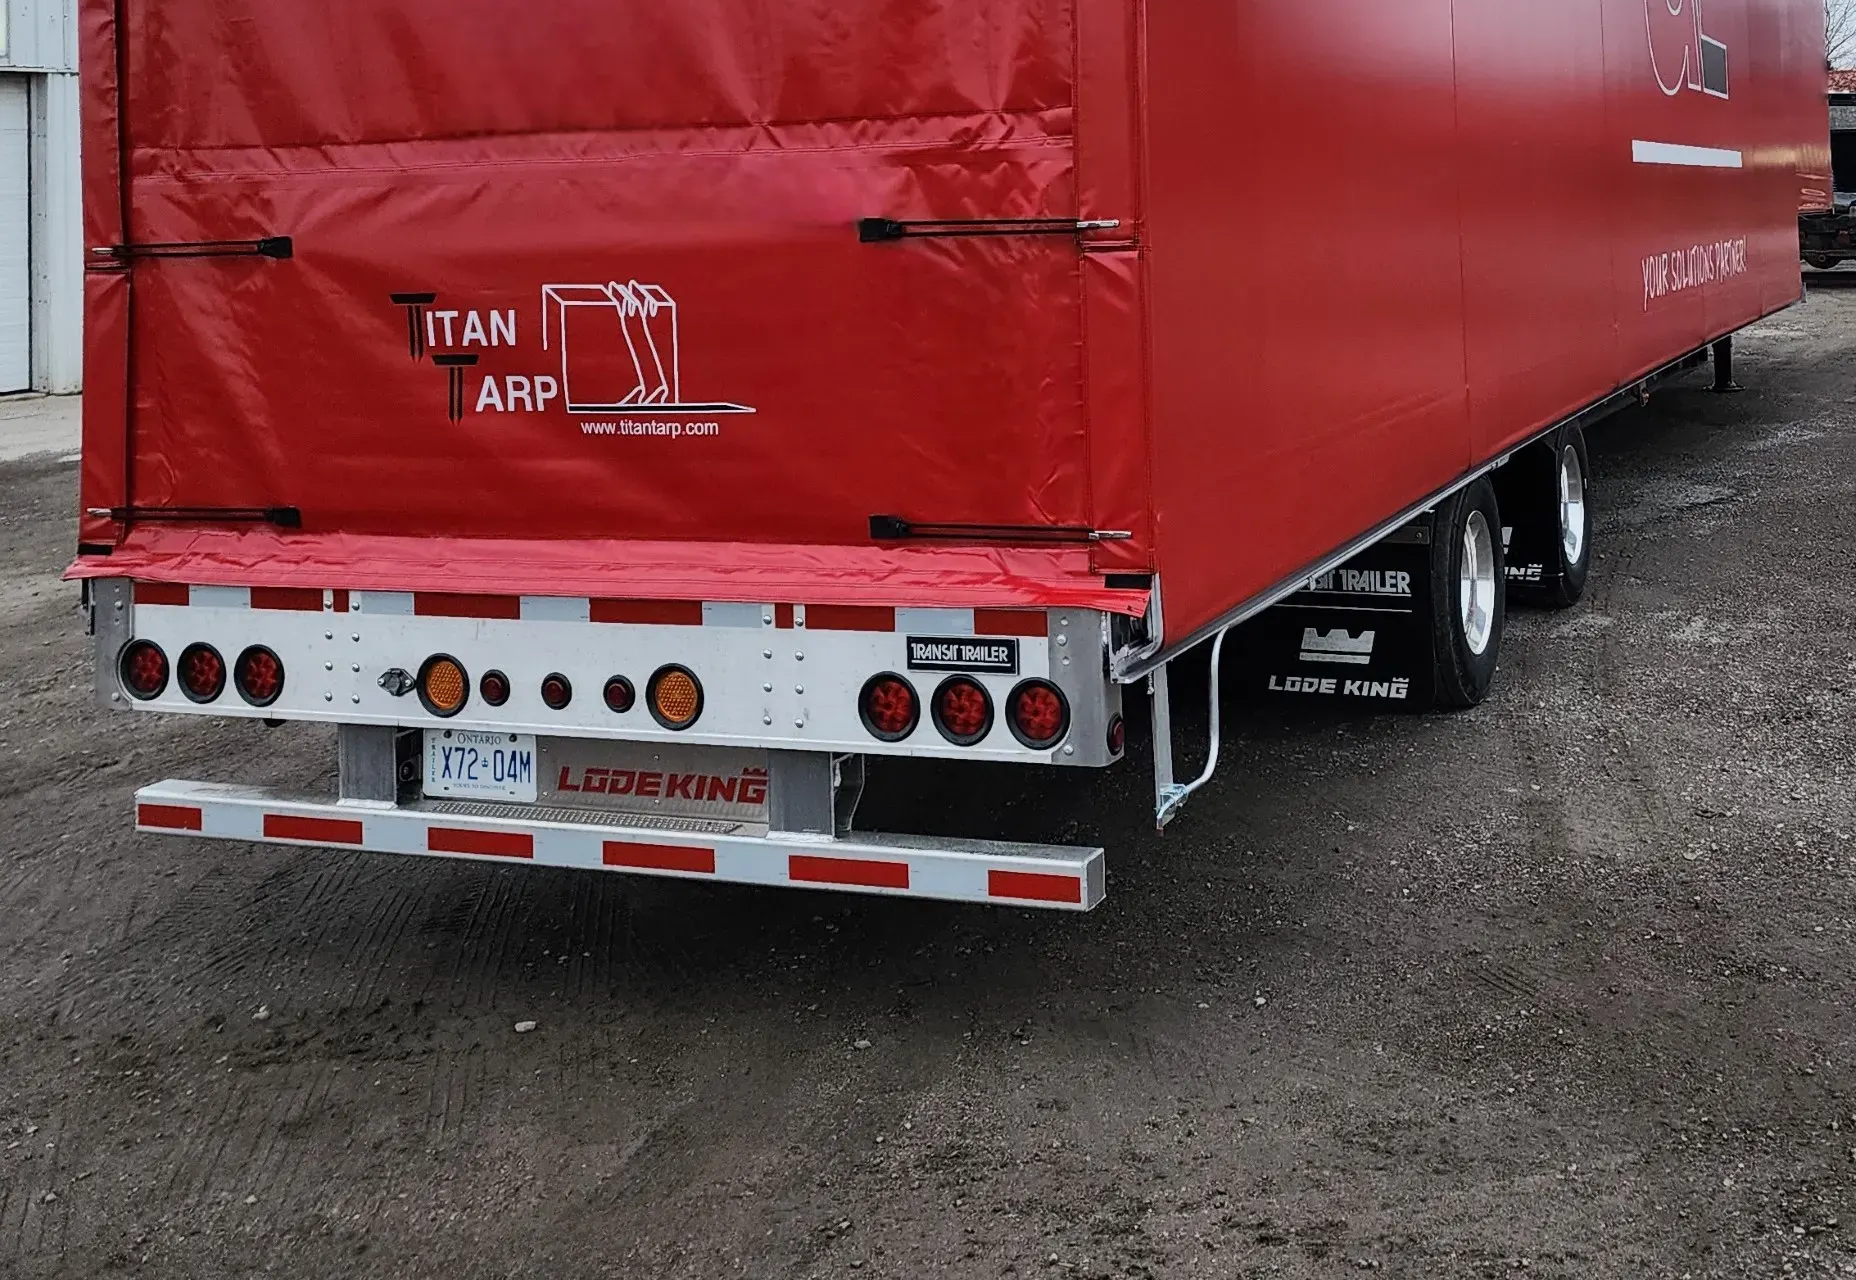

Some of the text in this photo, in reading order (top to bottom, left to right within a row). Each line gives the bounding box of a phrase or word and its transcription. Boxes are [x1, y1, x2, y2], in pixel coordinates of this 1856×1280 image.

[1642, 234, 1747, 312] YOUR SOLUTIONS PARTNER!
[389, 292, 517, 365] TITAN
[431, 353, 559, 428] TARP
[580, 418, 720, 439] www.titantarp.com
[1339, 569, 1411, 594] TRAILER
[910, 643, 1009, 662] TRANSIT TRAILER
[1268, 675, 1410, 699] LODE KING
[457, 732, 502, 746] ONTARIO
